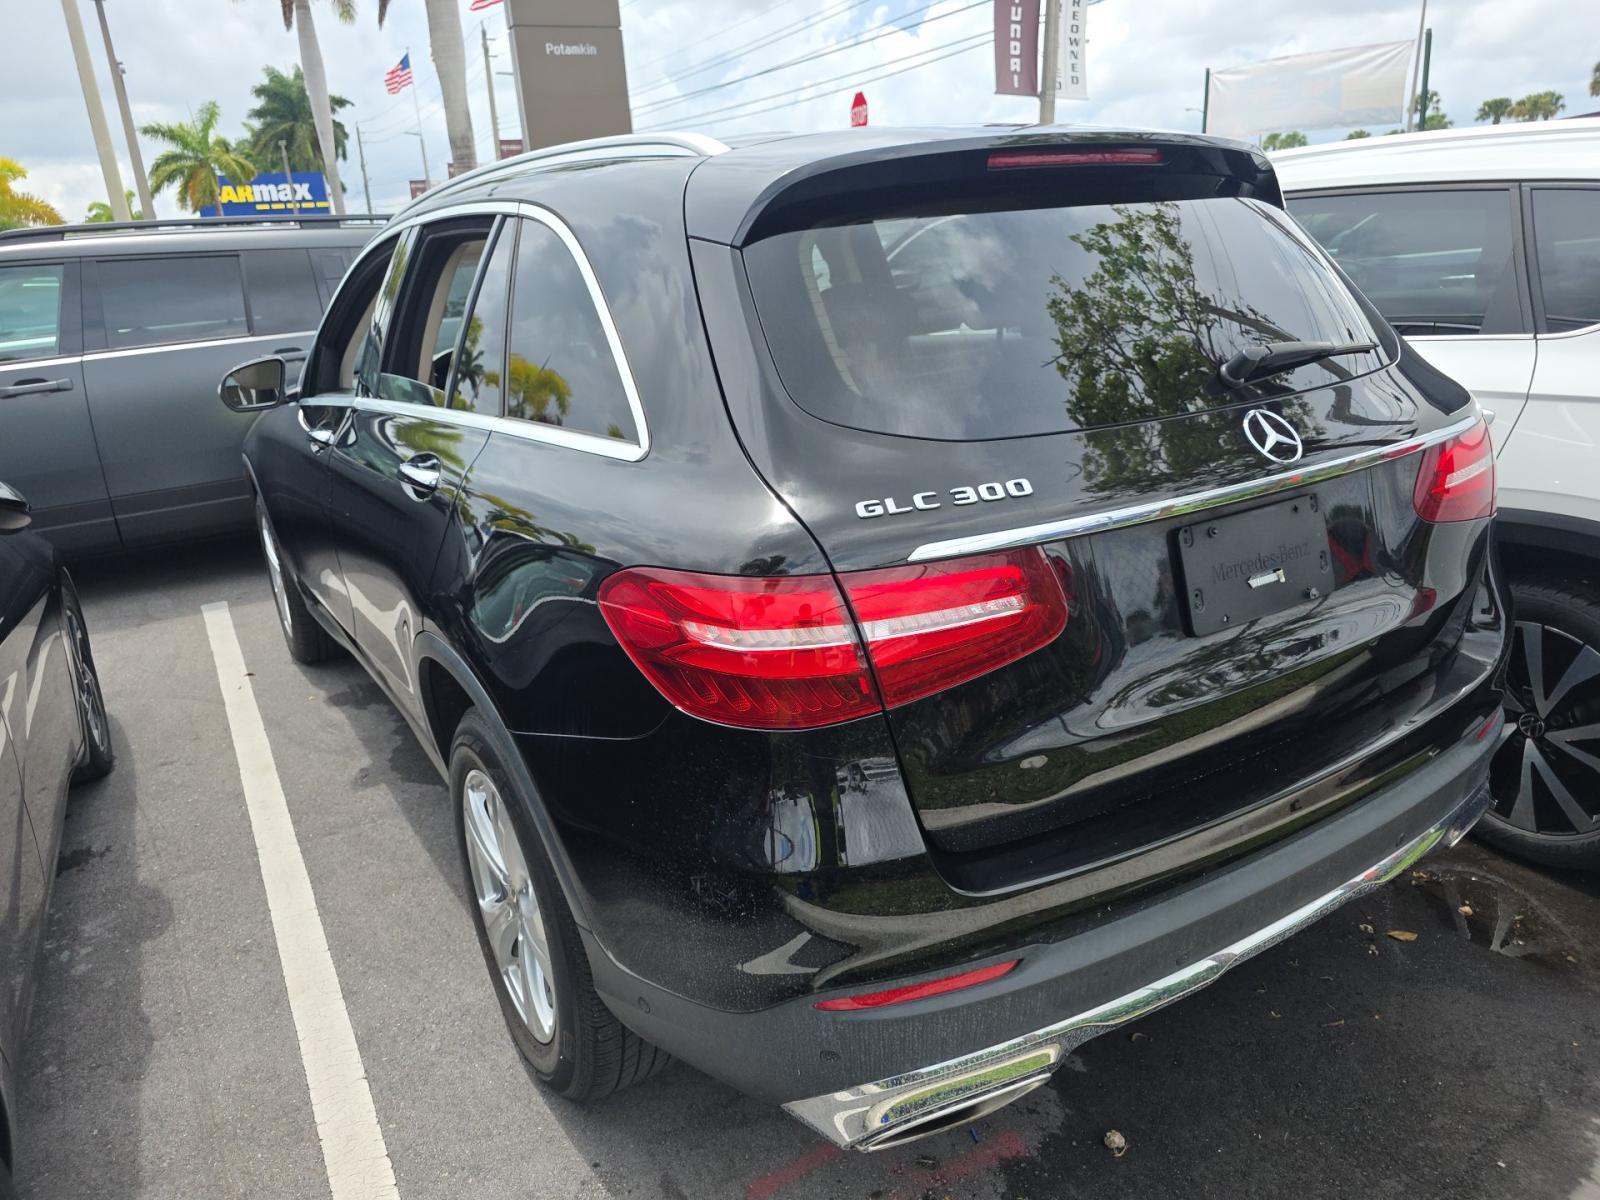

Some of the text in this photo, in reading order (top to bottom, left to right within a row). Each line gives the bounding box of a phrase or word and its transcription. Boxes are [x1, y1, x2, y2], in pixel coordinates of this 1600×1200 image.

[545, 42, 598, 56] Potamkin
[219, 183, 313, 204] ARmax
[855, 478, 1034, 519] GLC 300
[1212, 542, 1312, 583] Mercedes-Benz
